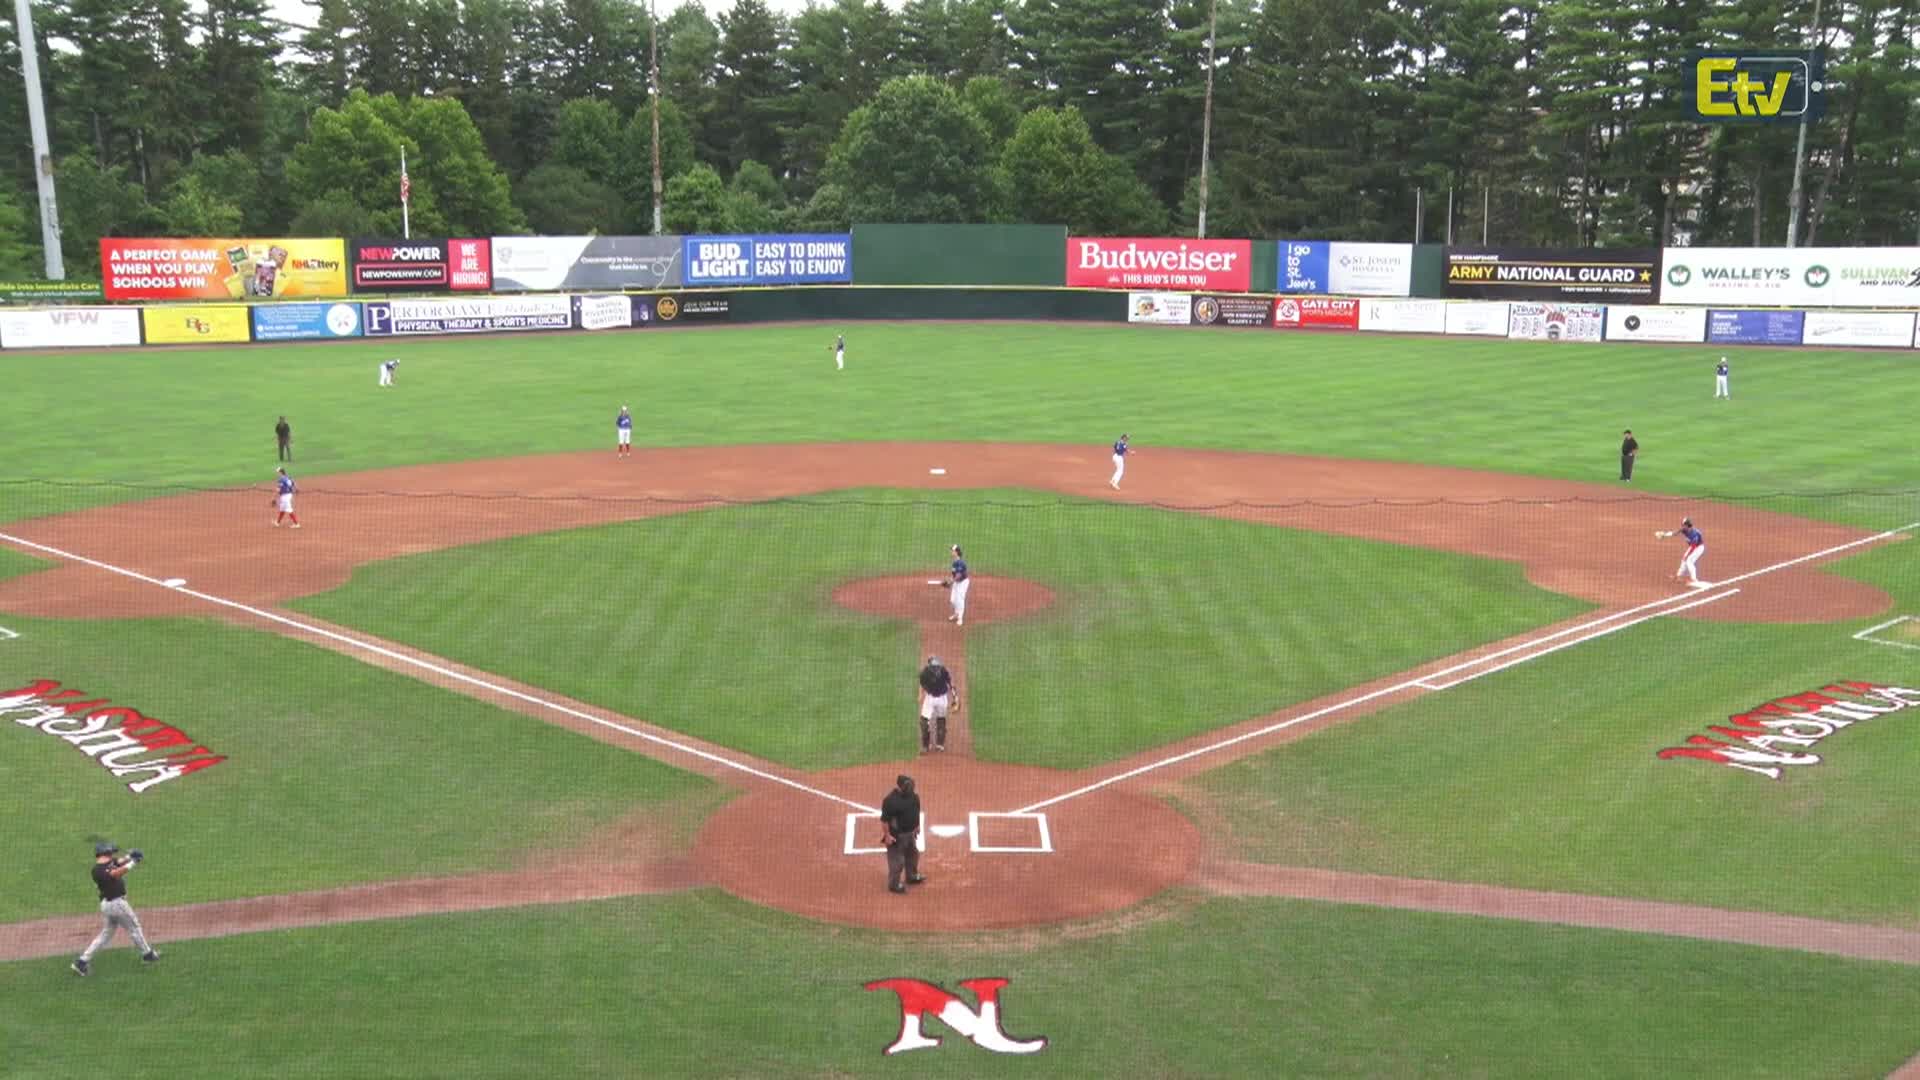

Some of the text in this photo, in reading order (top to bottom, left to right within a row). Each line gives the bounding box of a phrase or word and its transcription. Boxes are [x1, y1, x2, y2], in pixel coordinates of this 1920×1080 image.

[110, 249, 120, 260] A
[122, 249, 177, 260] PERFECT
[360, 247, 440, 260] NEWPOWER
[461, 243, 478, 256] WE
[699, 243, 741, 259] BUD
[755, 242, 846, 258] EASY TO DRINK
[1294, 246, 1310, 256] go
[1079, 242, 1237, 271] Budweiser
[1288, 255, 1300, 266] to
[112, 264, 152, 274] WHEN
[154, 264, 181, 274] YOU
[461, 258, 478, 271] ARE
[691, 260, 750, 277] LIGHT
[755, 260, 846, 276] EASY TO ENJOY
[453, 272, 487, 284] HIRING!
[1287, 266, 1302, 278] St.
[1450, 266, 1635, 282] ARMY NATIONAL GUARD
[1701, 266, 1791, 280] WALLEY'S
[1840, 267, 1909, 280] SULLIVAN
[113, 277, 176, 288] SCHOOLS
[1123, 274, 1207, 285] THIS BUD'S FOR YOU
[1286, 278, 1316, 290] Joe's
[1859, 279, 1905, 287] AND AUTO
[1302, 300, 1355, 310] GATE CITY
[49, 312, 99, 325] VFW
[399, 320, 440, 331] PHYSICAL
[444, 318, 481, 329] THERAPY
[484, 318, 492, 328] &
[494, 317, 526, 327] SPORTS
[862, 978, 1048, 1056] N
